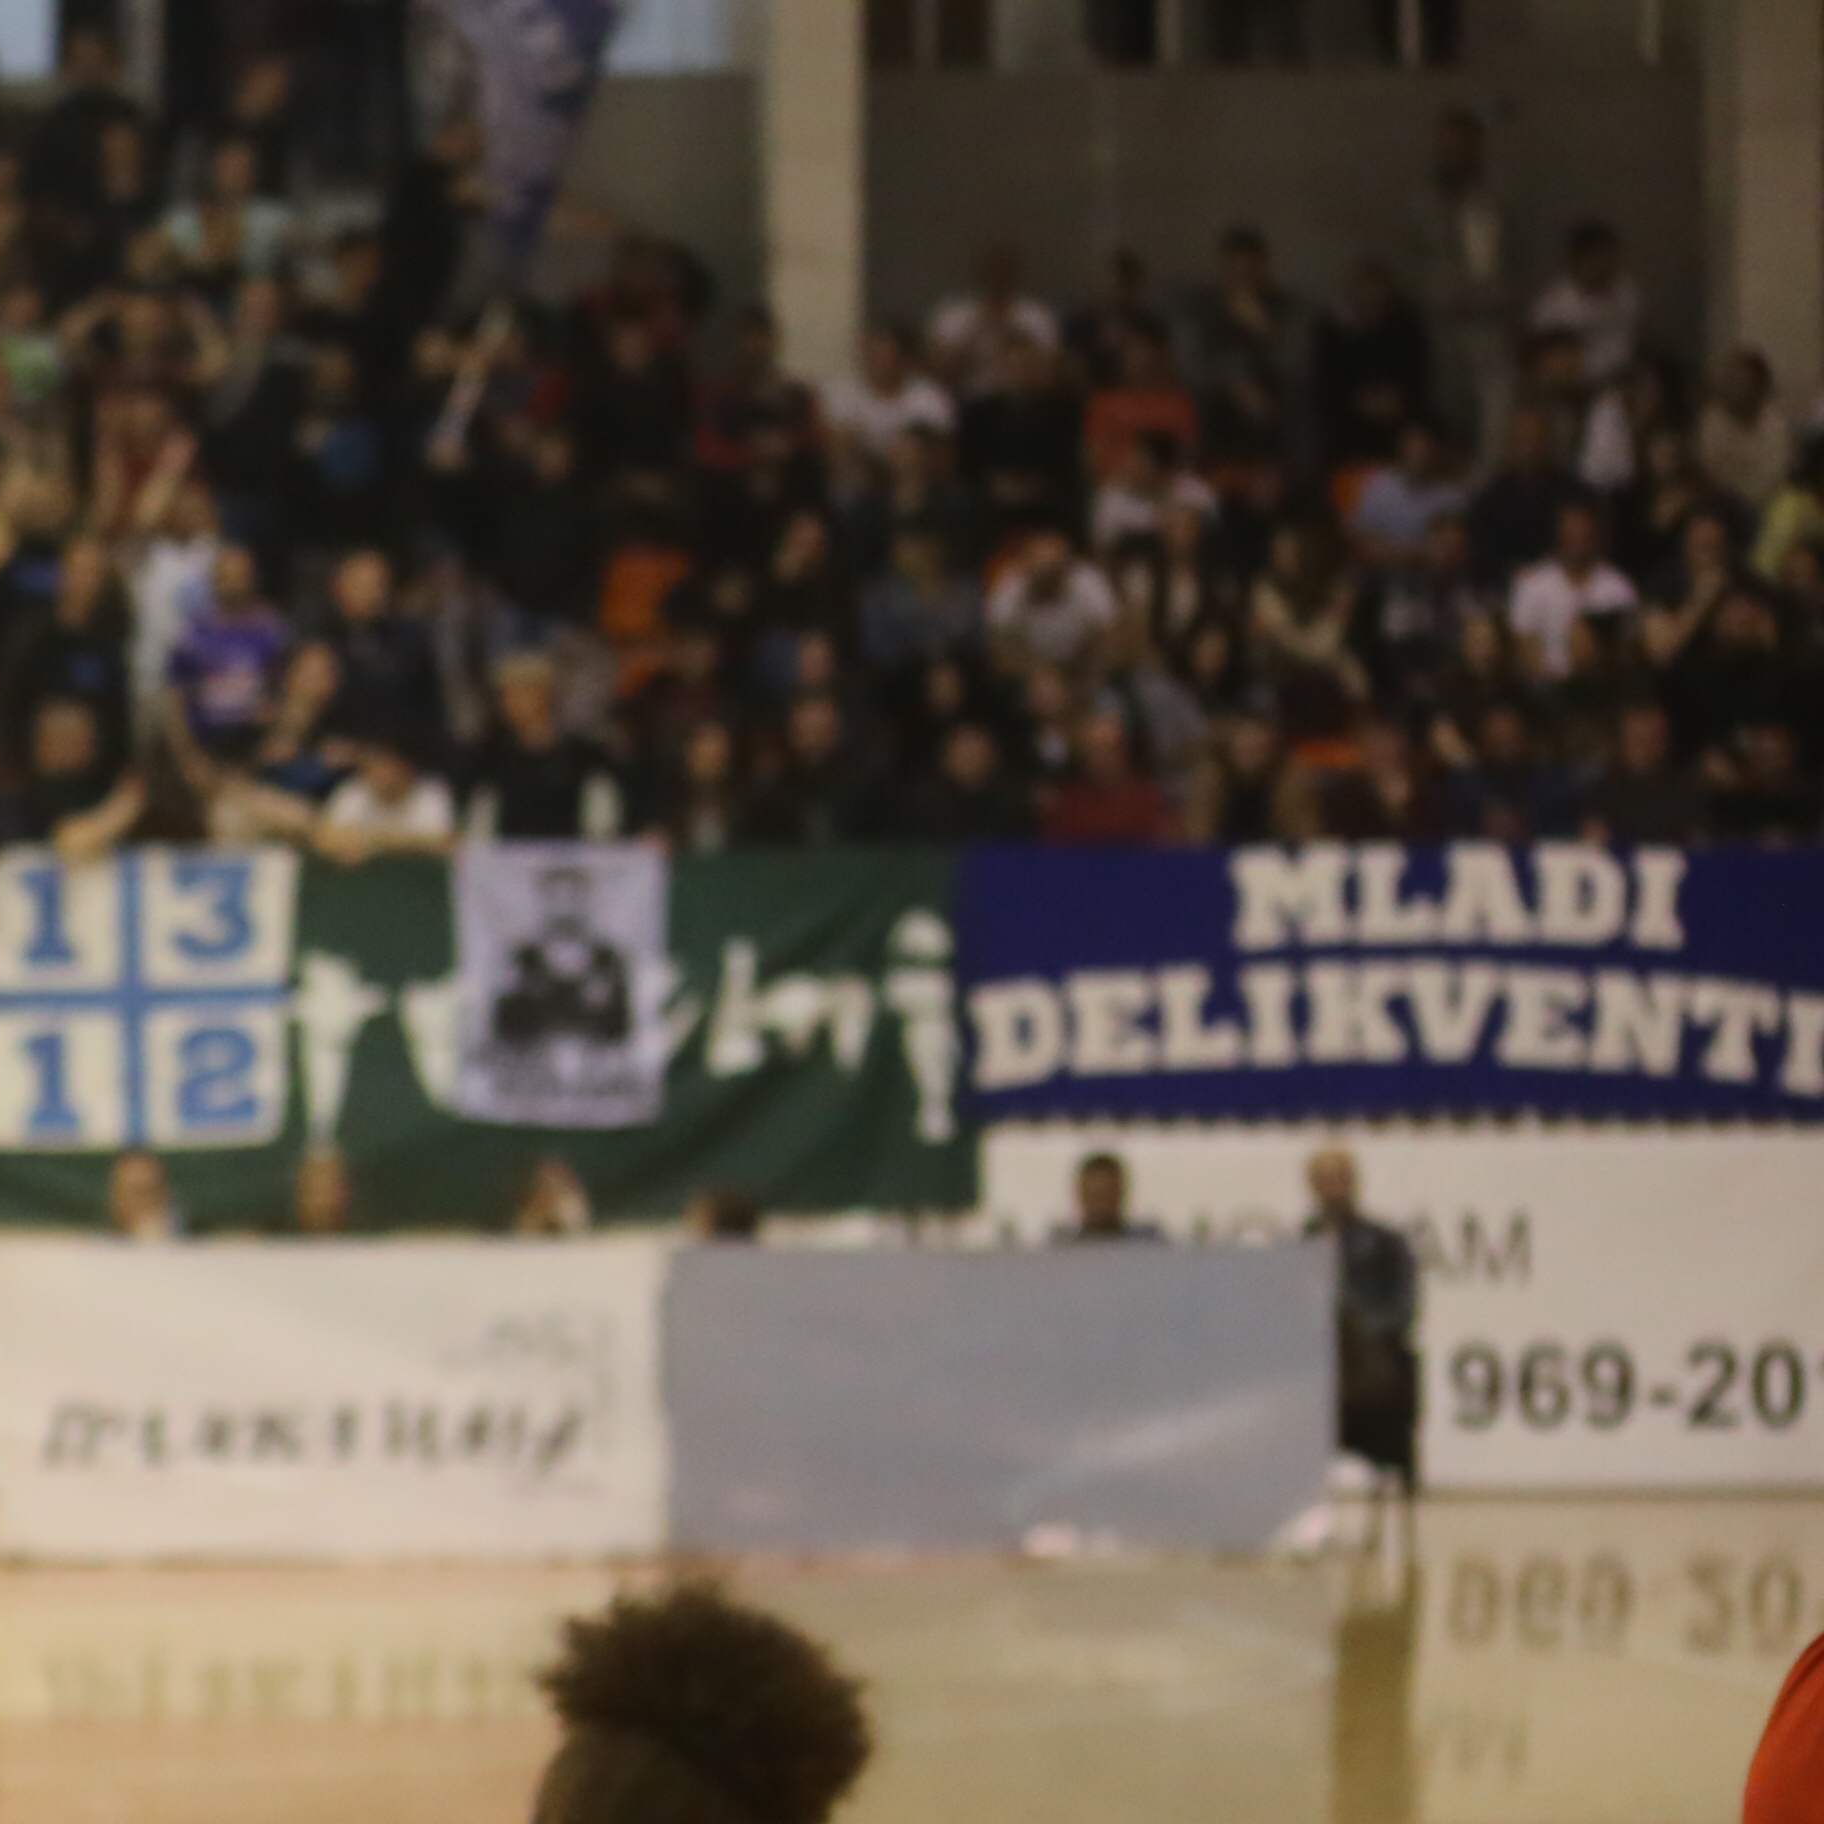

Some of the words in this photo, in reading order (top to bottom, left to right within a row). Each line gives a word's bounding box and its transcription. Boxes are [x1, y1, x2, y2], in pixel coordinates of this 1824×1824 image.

[1228, 841, 1687, 951] MLADI
[967, 956, 1824, 1097] DELIKVENTI
[1450, 1338, 1824, 1432] 969-20
